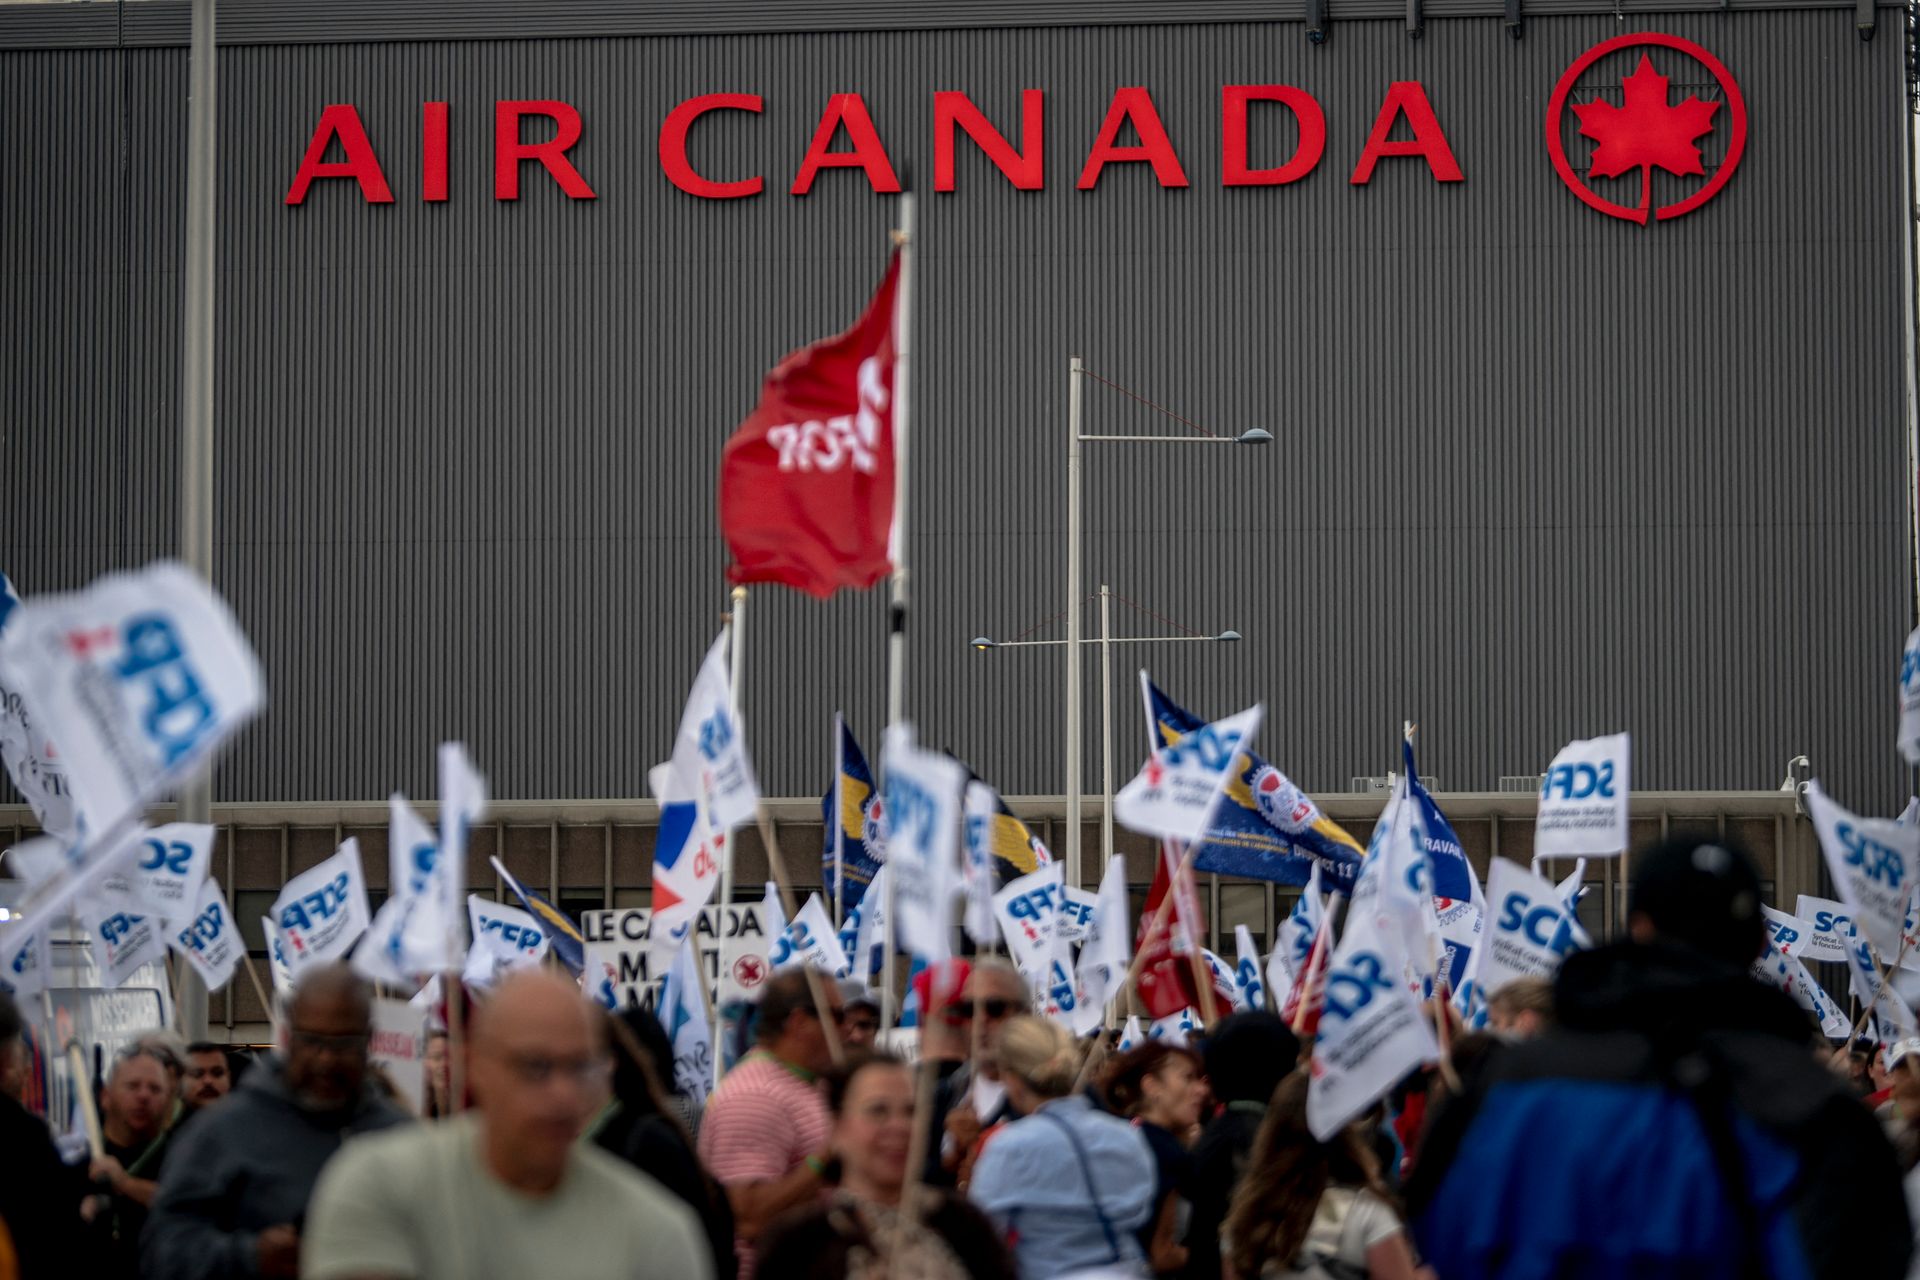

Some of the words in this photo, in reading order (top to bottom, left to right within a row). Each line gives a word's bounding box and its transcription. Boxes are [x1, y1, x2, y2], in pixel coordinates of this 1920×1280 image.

[286, 100, 595, 203] AIR
[660, 82, 1463, 197] CANADA
[584, 912, 616, 942] LE
[620, 907, 764, 942] CADA
